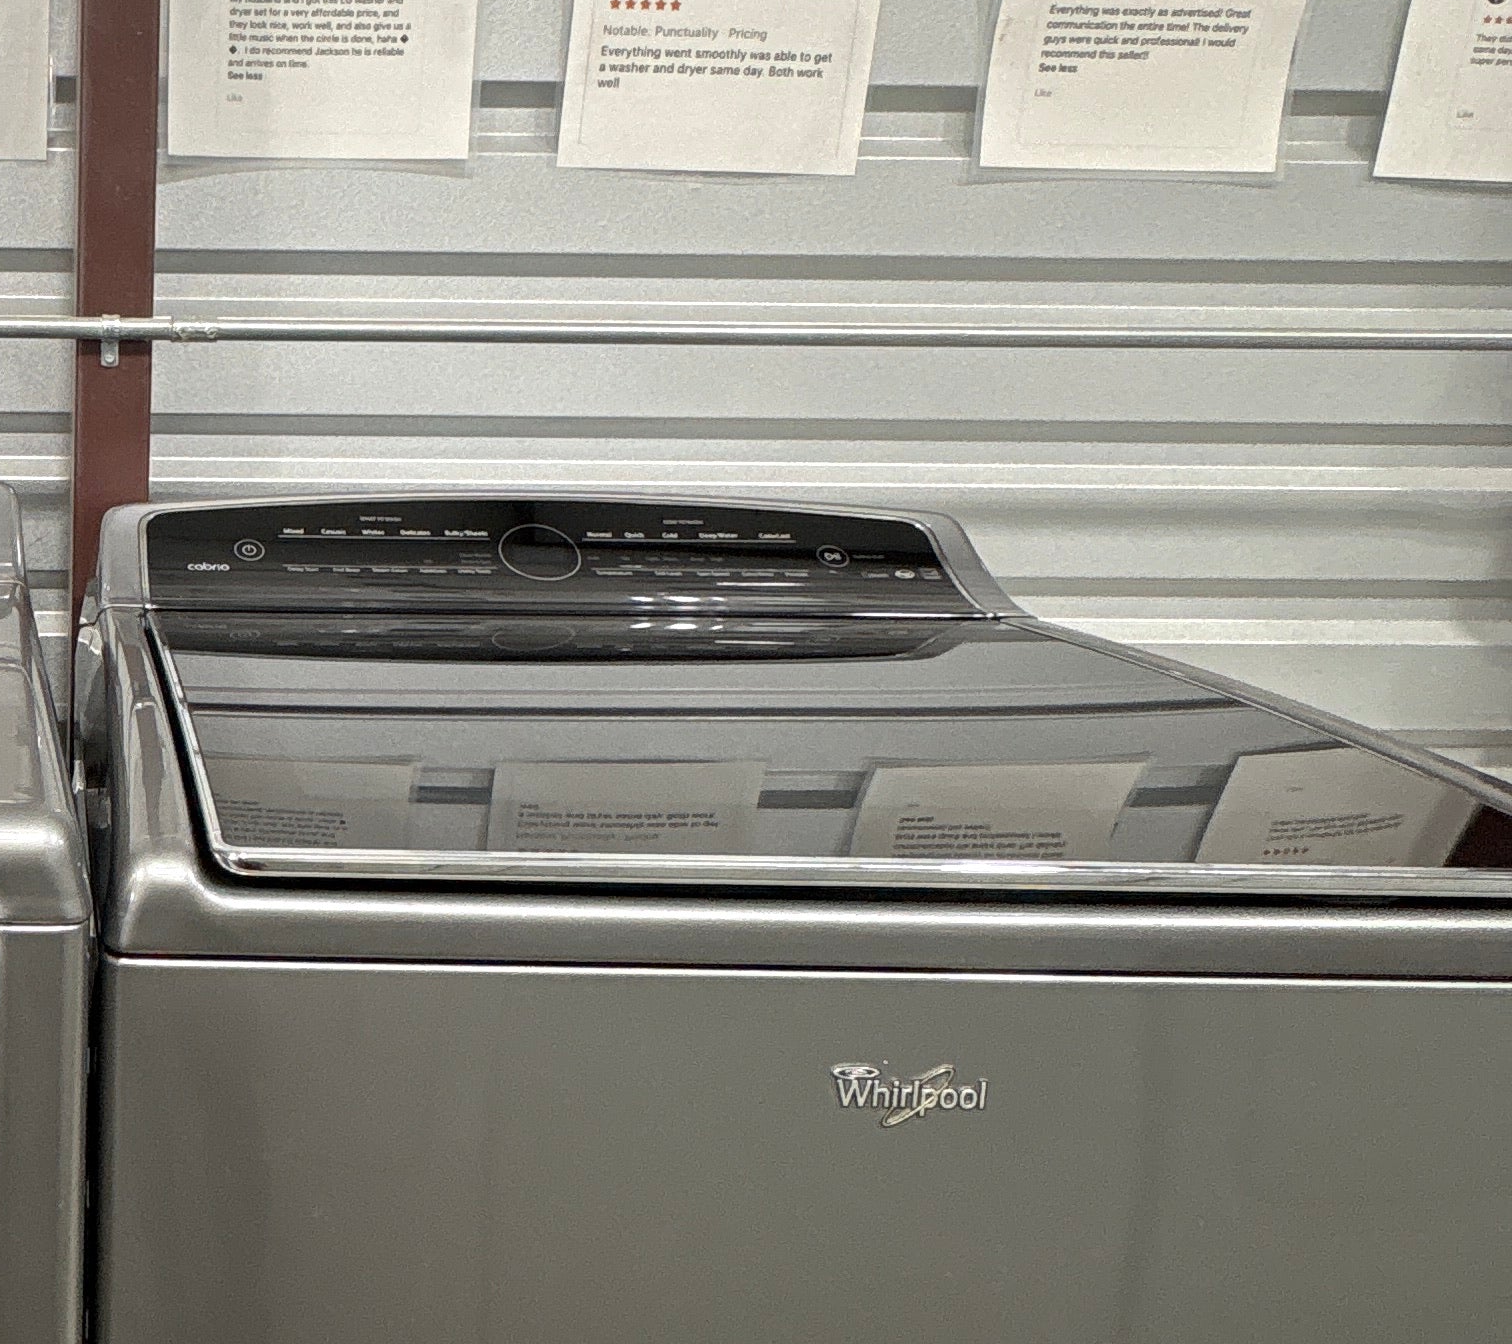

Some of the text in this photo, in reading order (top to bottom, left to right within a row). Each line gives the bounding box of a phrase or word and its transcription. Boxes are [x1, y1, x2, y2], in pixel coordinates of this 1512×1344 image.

[654, 25, 718, 40] Punctuality
[728, 27, 767, 41] Pricing
[600, 45, 832, 64] Everything went smoothly was able to get
[598, 63, 606, 72] a
[608, 61, 649, 73] washer
[652, 62, 674, 73] and
[677, 63, 707, 77] dryer
[710, 66, 740, 75] same
[768, 65, 794, 76] Both
[796, 65, 823, 77] work
[597, 75, 620, 87] well
[835, 1071, 989, 1122] Whirlpool
